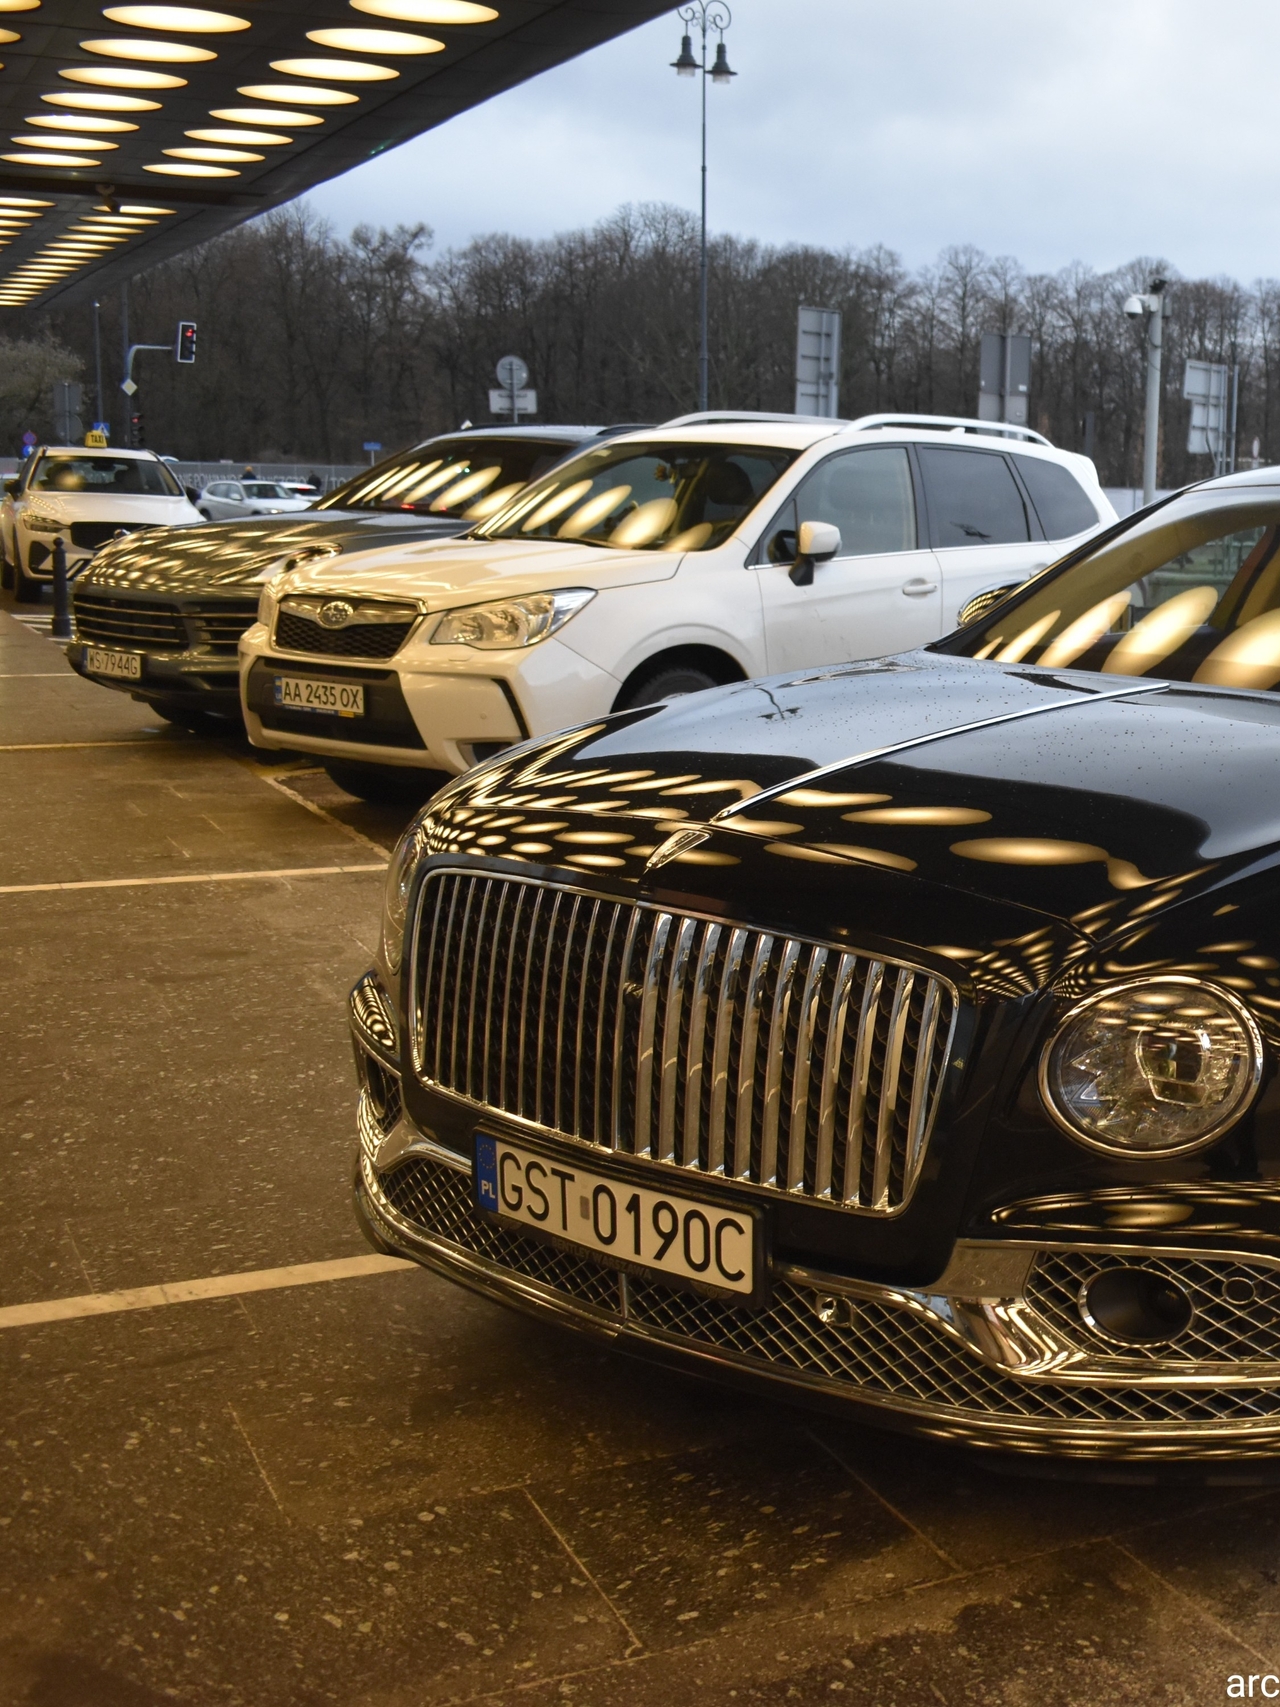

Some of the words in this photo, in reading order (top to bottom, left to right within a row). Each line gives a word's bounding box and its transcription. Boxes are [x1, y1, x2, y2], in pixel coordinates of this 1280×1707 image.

[91, 434, 104, 443] TAXI
[103, 653, 138, 675] 7944G
[284, 681, 302, 702] AA
[305, 684, 337, 706] 2435
[340, 688, 360, 709] OX
[481, 1180, 496, 1199] PL
[500, 1151, 575, 1231] GST
[592, 1184, 746, 1281] 0190C
[552, 1237, 590, 1259] BENTLEY
